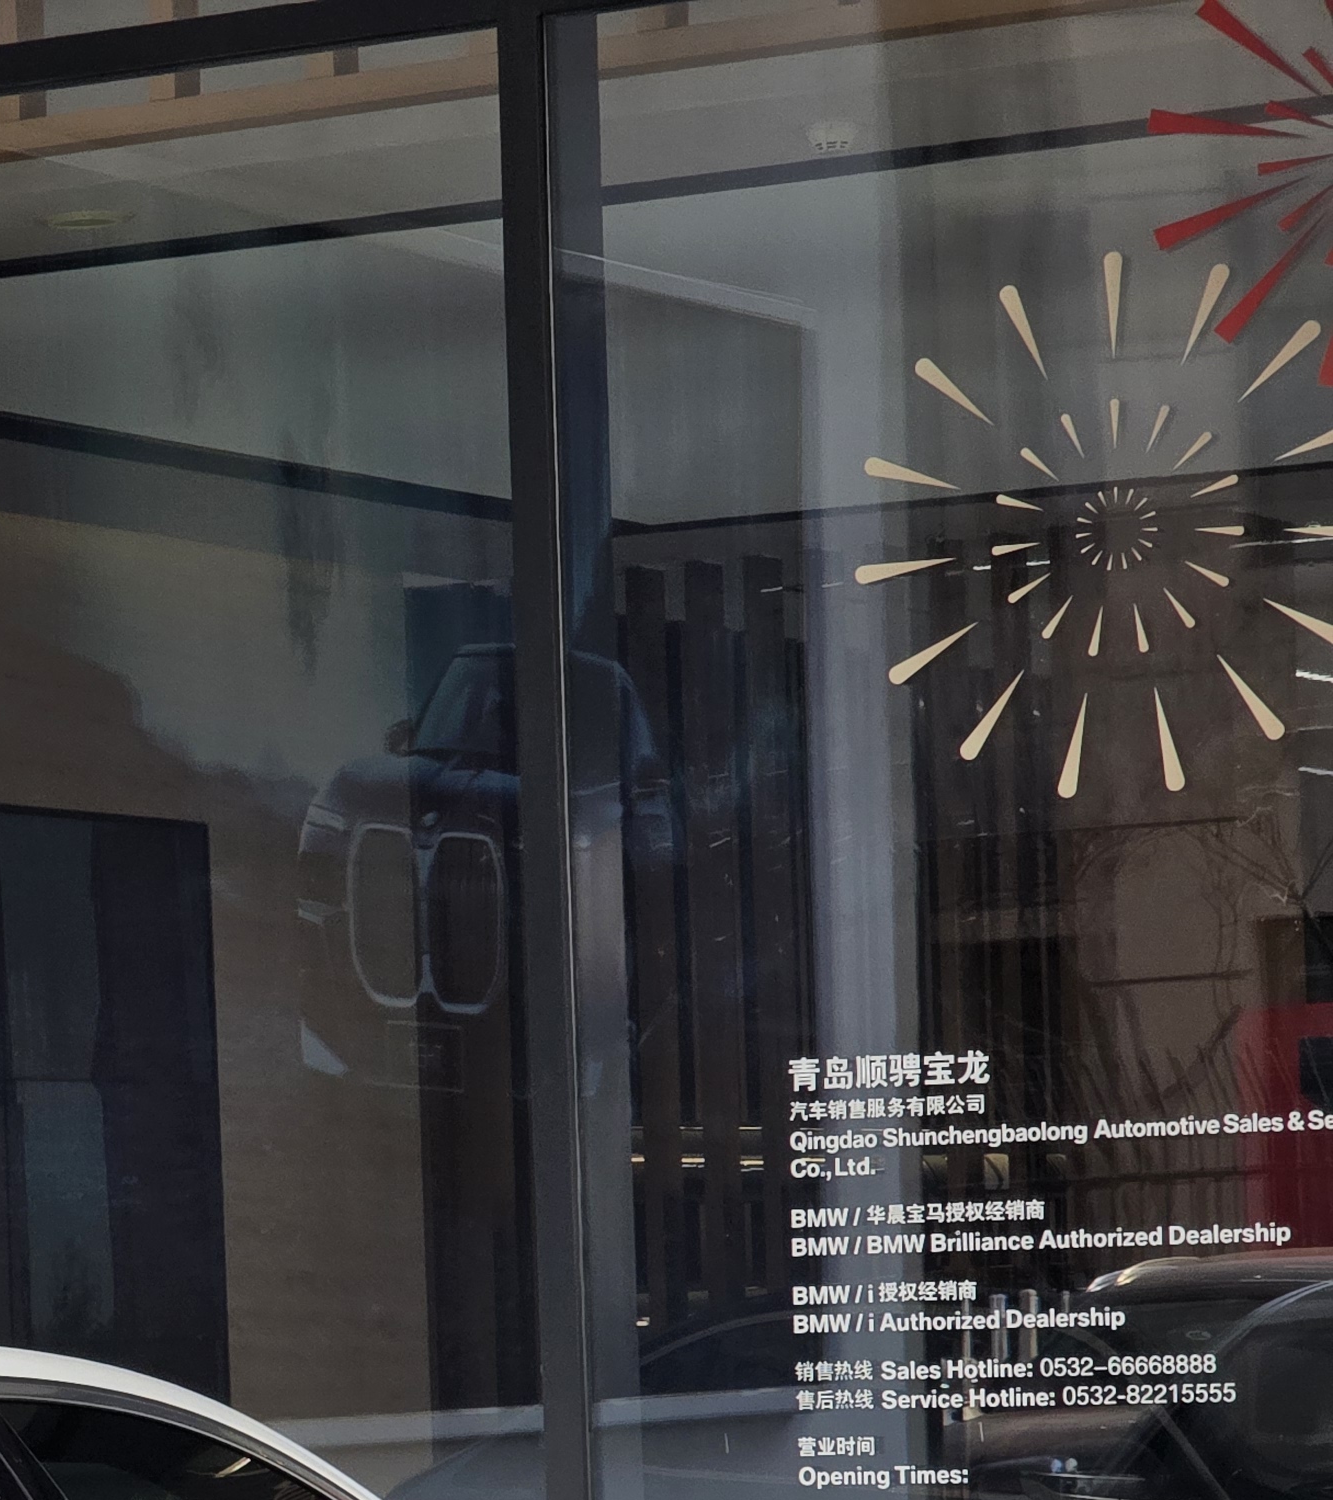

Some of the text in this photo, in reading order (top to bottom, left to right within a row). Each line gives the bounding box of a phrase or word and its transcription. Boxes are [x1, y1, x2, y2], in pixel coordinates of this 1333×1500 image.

[788, 1050, 991, 1092] 青岛顺骋宝龙
[789, 1093, 985, 1122] 汽车销售服务有限公司
[789, 1129, 878, 1154] Qingdao
[882, 1121, 1088, 1148] Shunchengbaolong
[1093, 1114, 1221, 1139] Automotive
[1222, 1112, 1284, 1134] Sales
[1287, 1111, 1305, 1131] &
[790, 1207, 849, 1229] BMW
[866, 1198, 1045, 1226] 华晨宝马授权经销商
[791, 1236, 850, 1257] BMW
[866, 1233, 926, 1255] BMW
[930, 1230, 1035, 1253] Brilliance
[1038, 1225, 1163, 1250] Authorized
[1168, 1221, 1291, 1247] Dealership
[792, 1284, 851, 1306] BMW
[867, 1283, 874, 1304] i
[877, 1279, 977, 1303] 授权经销商
[793, 1312, 852, 1334] BMW
[868, 1312, 875, 1333] i
[879, 1309, 1001, 1332] Authorized
[1005, 1305, 1126, 1331] Dealership
[794, 1359, 874, 1382] 销售热线
[880, 1360, 942, 1381] Sales
[946, 1357, 1033, 1380] Hotline:
[795, 1382, 1237, 1411] 售后热线 Service Hotline: 0532-82215555
[797, 1435, 876, 1457] 营业时间
[798, 1465, 969, 1490] Opening Times:
